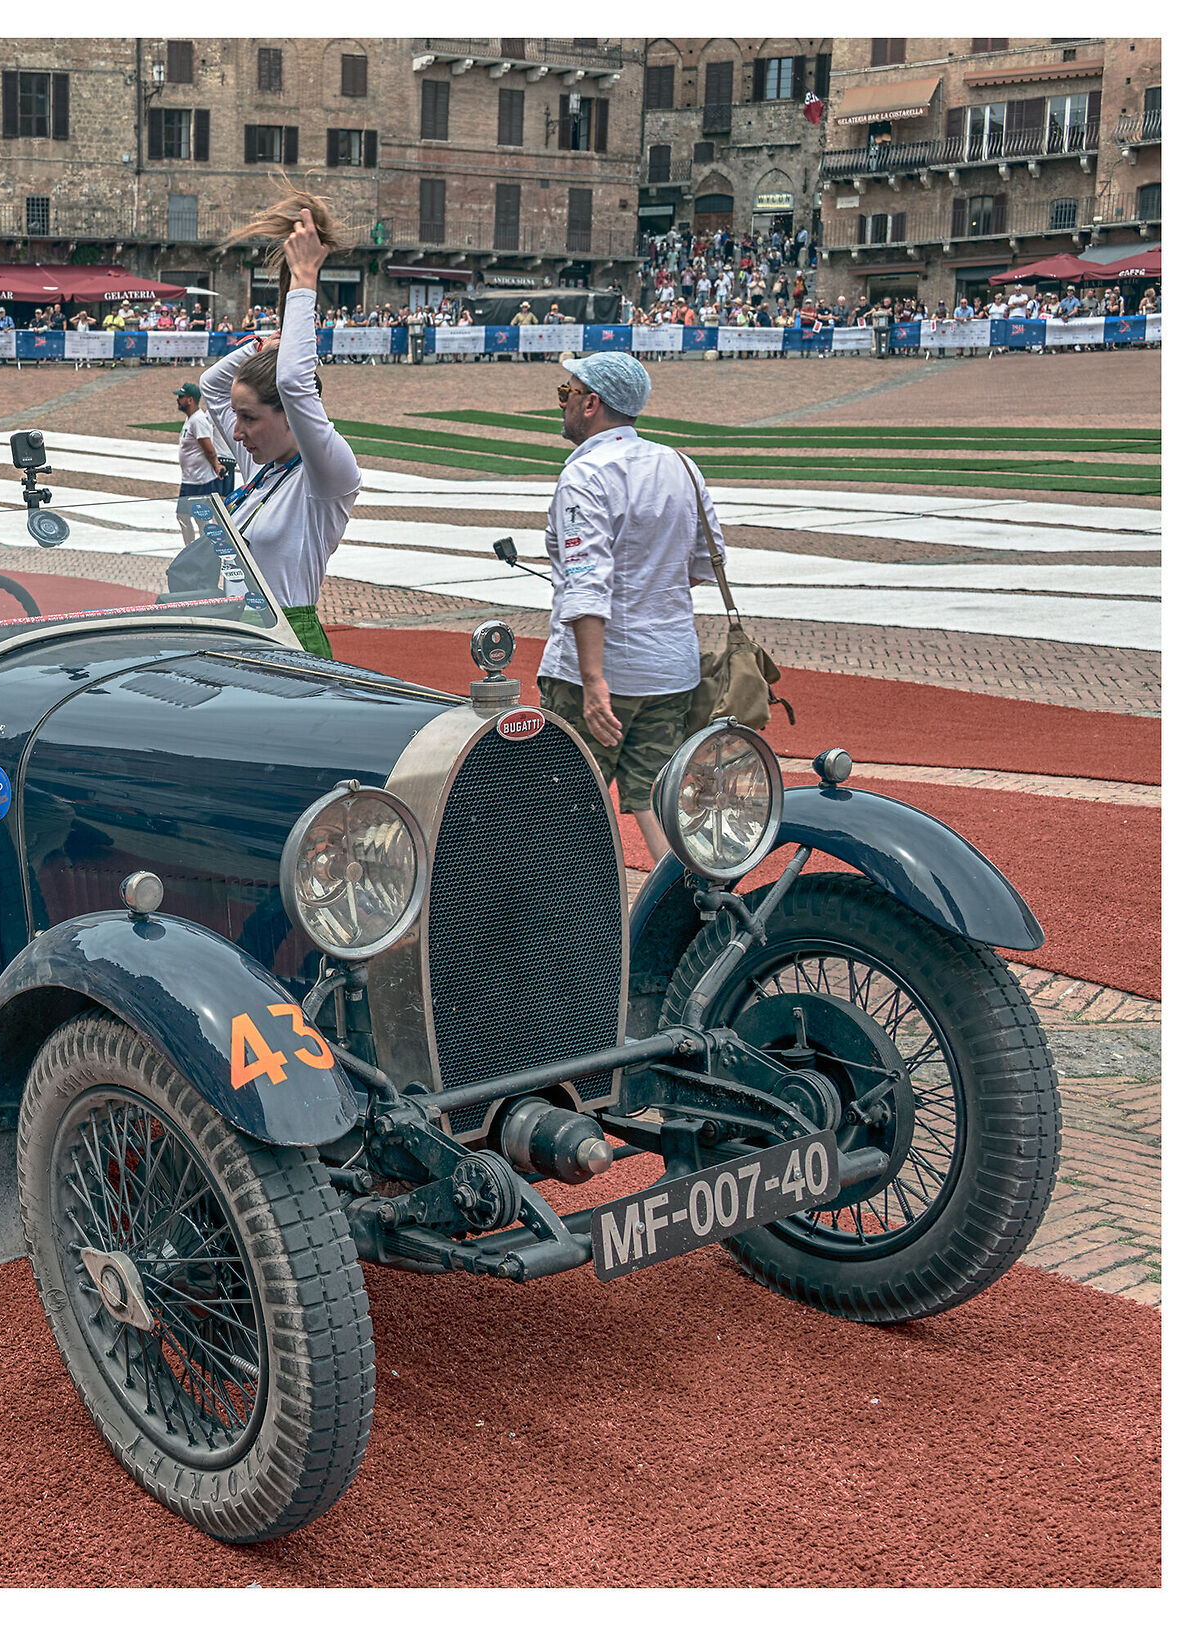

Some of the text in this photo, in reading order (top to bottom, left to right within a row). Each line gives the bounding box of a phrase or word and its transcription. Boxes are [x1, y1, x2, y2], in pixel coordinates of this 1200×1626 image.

[881, 112, 889, 120] LA
[104, 289, 156, 301] GELATERIA
[503, 718, 540, 734] BUGATTI
[230, 1003, 335, 1091] 43
[601, 1141, 829, 1271] MF-007-40
